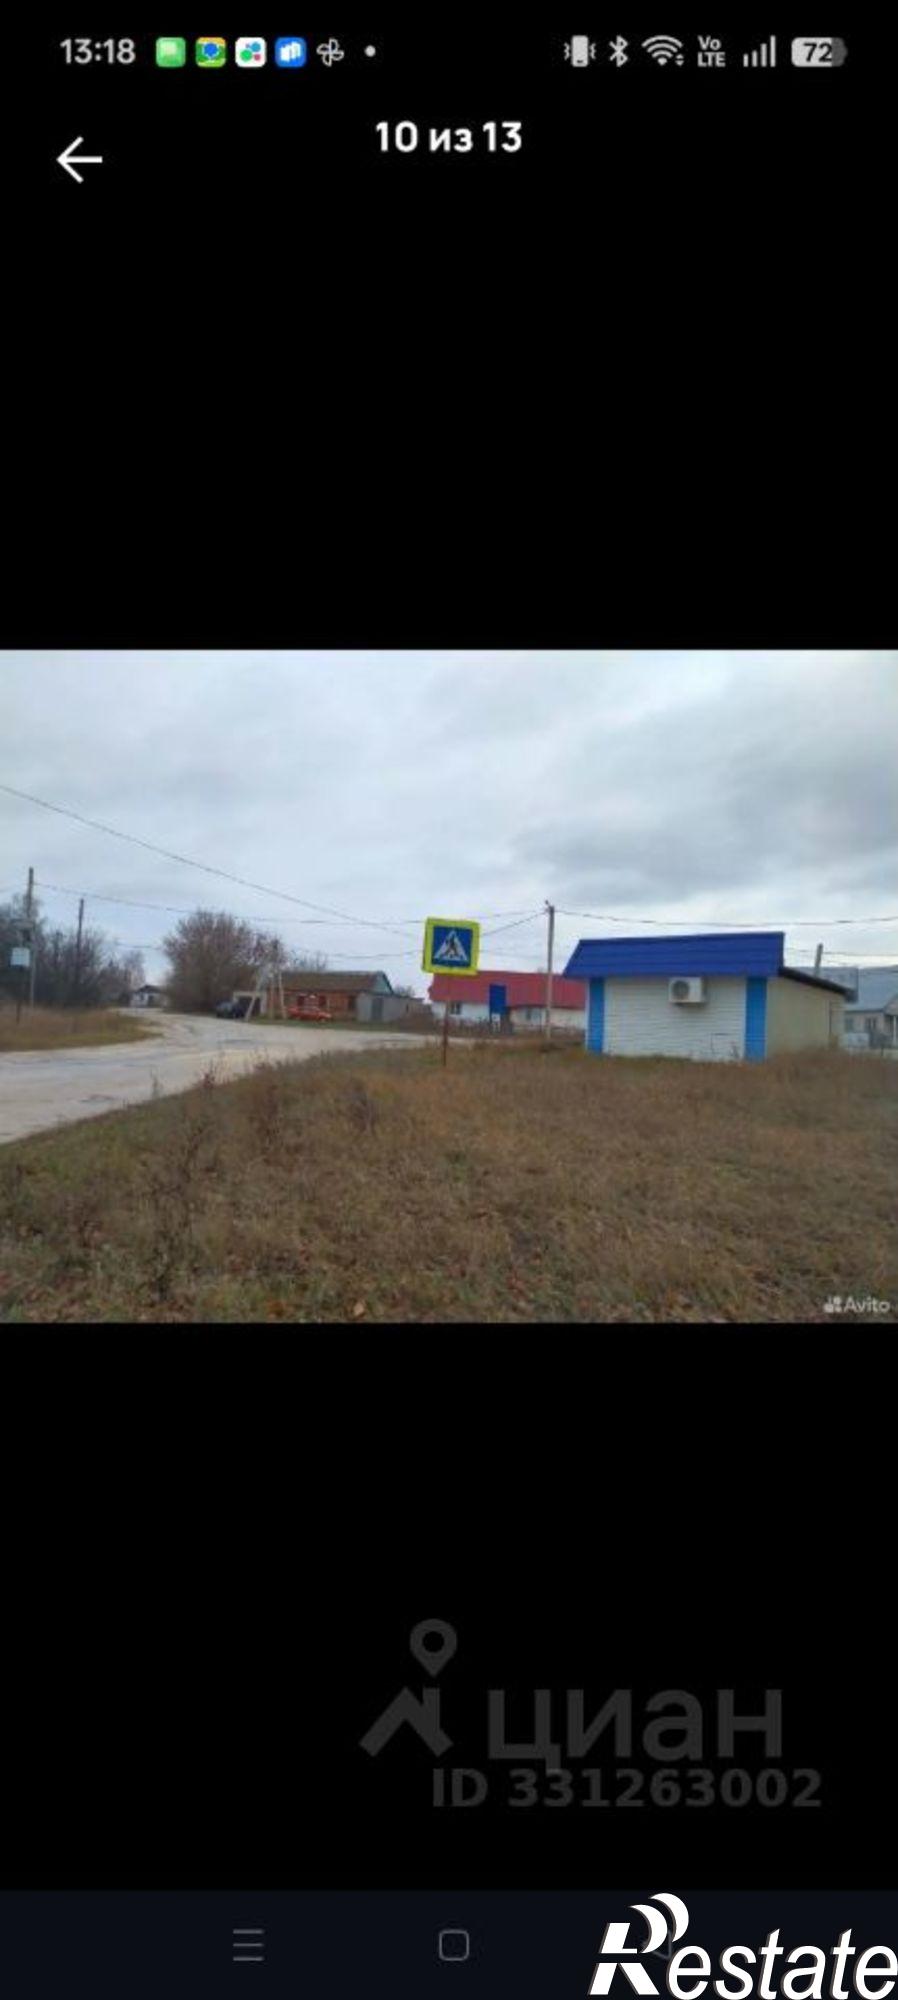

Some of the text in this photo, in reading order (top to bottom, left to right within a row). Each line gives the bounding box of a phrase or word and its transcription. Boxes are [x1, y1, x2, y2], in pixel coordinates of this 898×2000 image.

[60, 38, 136, 65] 13:18
[697, 35, 722, 50] Vo
[802, 41, 833, 63] 72
[697, 51, 726, 67] LTE
[375, 121, 522, 153] 10 из 13
